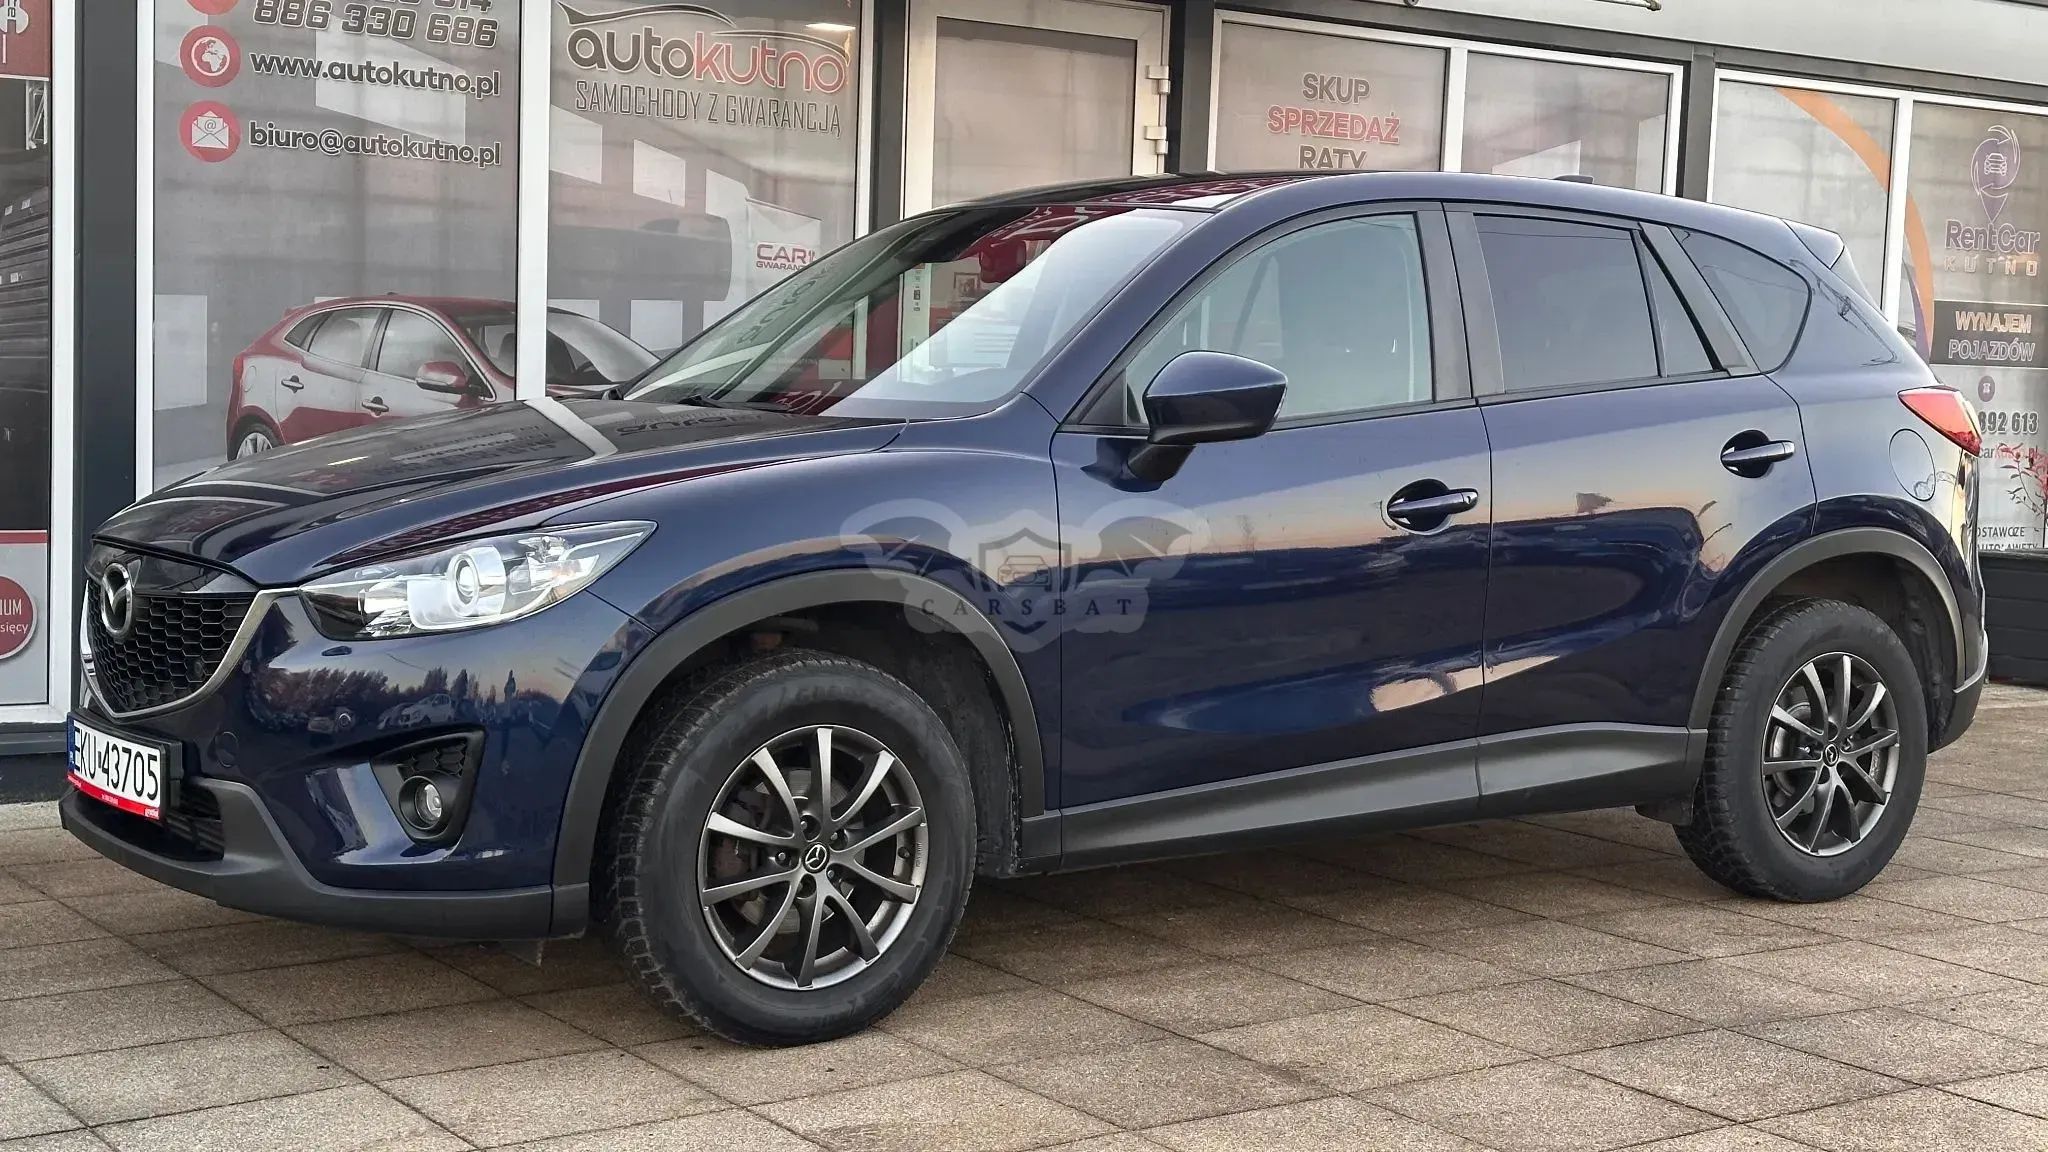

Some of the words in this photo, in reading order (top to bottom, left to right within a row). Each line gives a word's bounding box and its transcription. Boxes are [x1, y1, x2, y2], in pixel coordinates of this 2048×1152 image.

[253, 0, 332, 29] 886
[341, 3, 417, 39] 330
[425, 12, 499, 48] 686
[250, 52, 500, 97] www.autokutno.pl
[567, 26, 845, 93] autokutno
[1302, 72, 1371, 104] SKUP
[575, 80, 702, 120] SAMOCHODY
[708, 93, 719, 123] Z
[725, 95, 842, 138] GWARANCJĄ
[1267, 105, 1400, 145] SPRZEDAŻ
[250, 122, 501, 166] biuro@autokutno.pl
[1299, 145, 1368, 169] RATY
[756, 260, 806, 271] GWARAN
[1944, 255, 2038, 276] KUTNO
[1955, 311, 2032, 334] WYNAJEM
[1948, 337, 2036, 361] POJAZDÓW
[2011, 411, 2038, 434] 613
